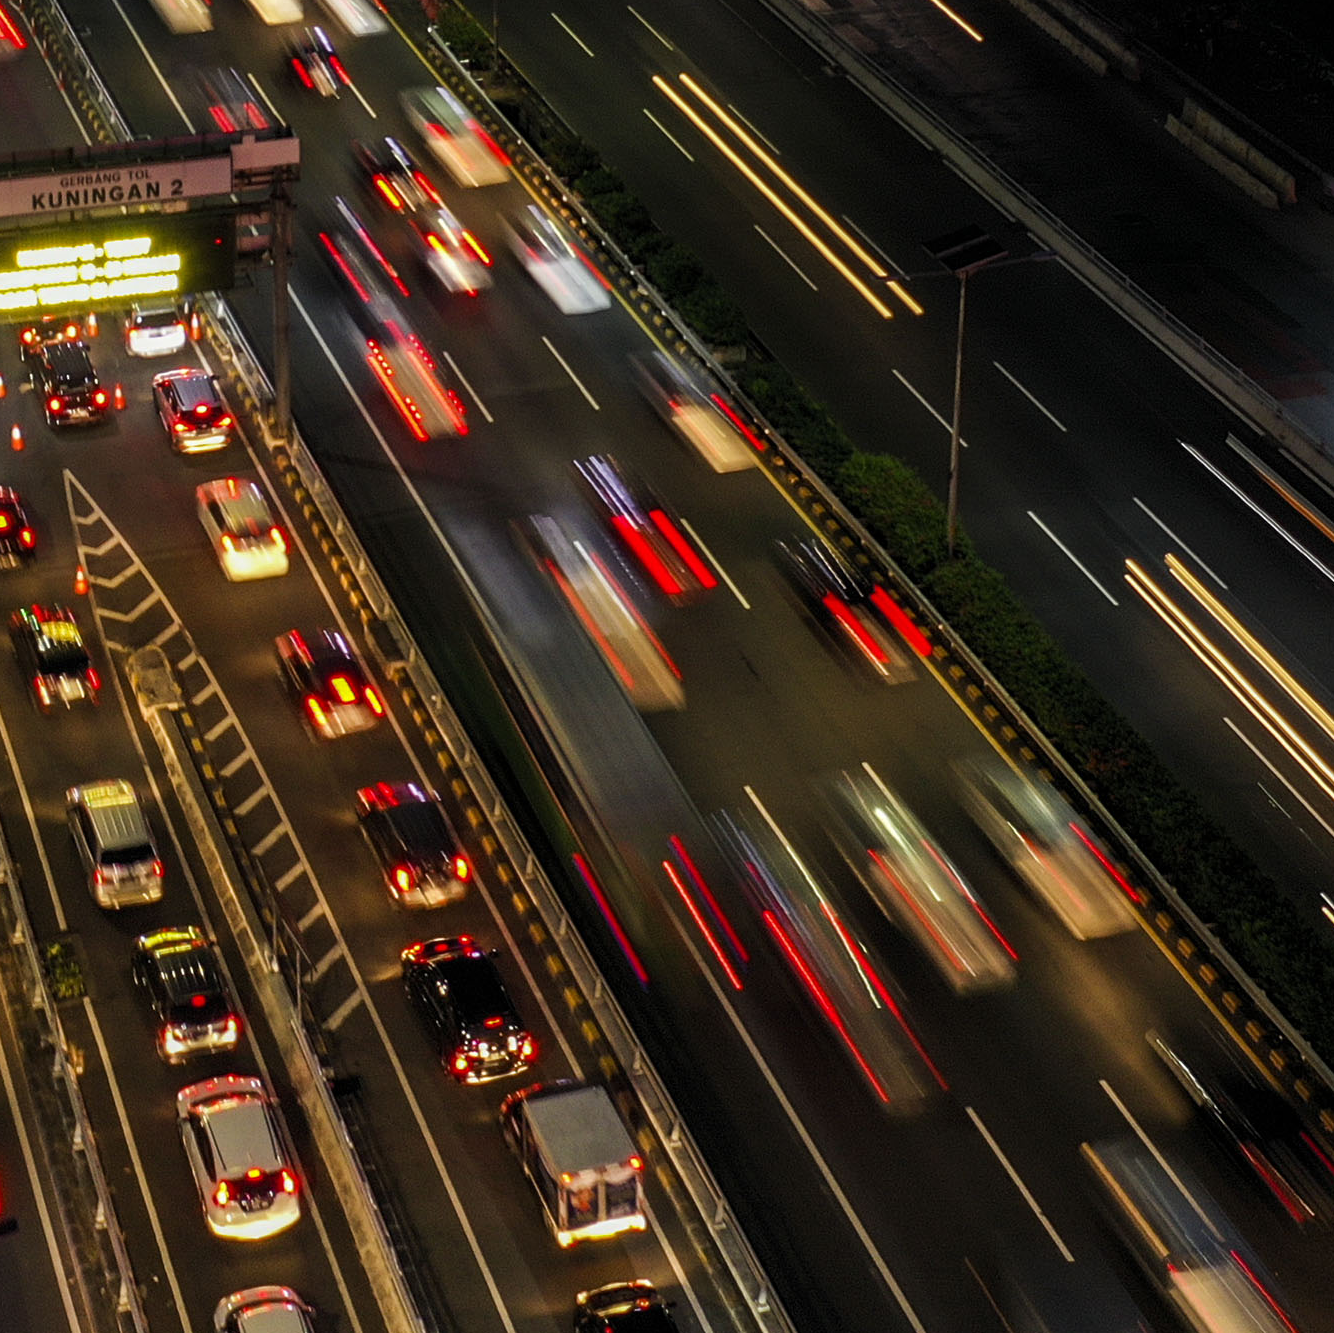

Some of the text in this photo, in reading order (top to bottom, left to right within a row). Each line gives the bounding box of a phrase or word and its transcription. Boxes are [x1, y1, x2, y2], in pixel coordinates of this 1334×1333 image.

[60, 168, 150, 188] GERBANG TOL
[32, 179, 184, 210] KUNINGAN 2
